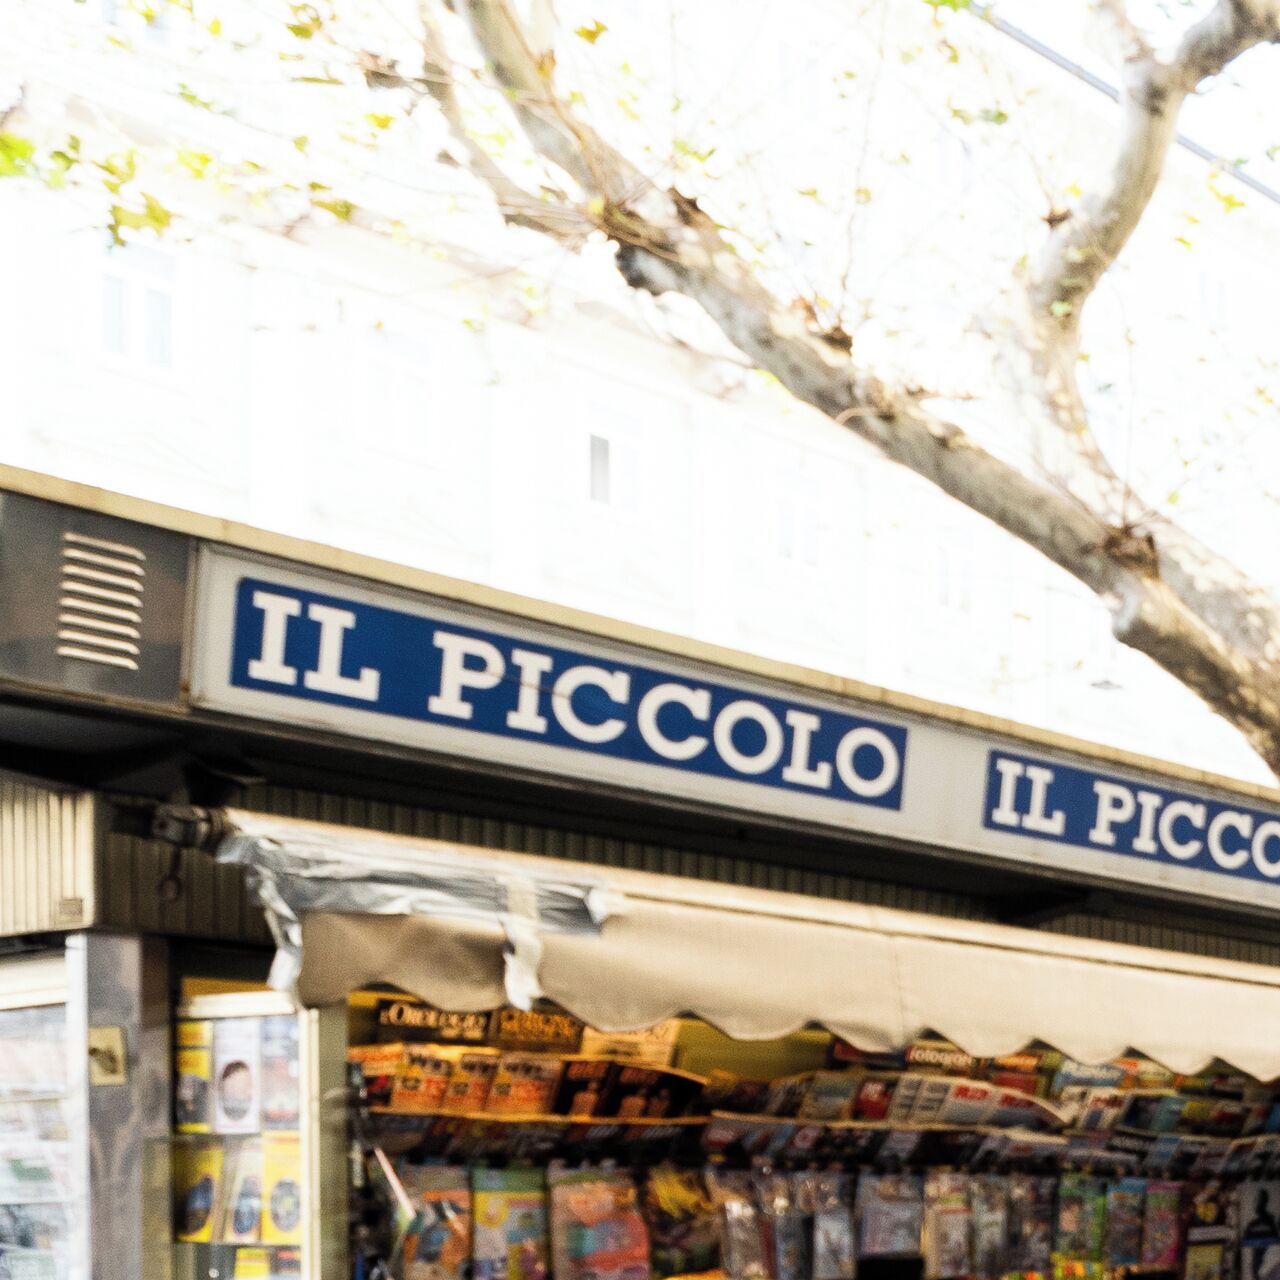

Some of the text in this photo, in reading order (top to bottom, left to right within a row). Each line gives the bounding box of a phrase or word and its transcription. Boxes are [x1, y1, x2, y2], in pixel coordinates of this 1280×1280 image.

[248, 590, 901, 798] IL PICCOLO
[991, 757, 1065, 835] IL
